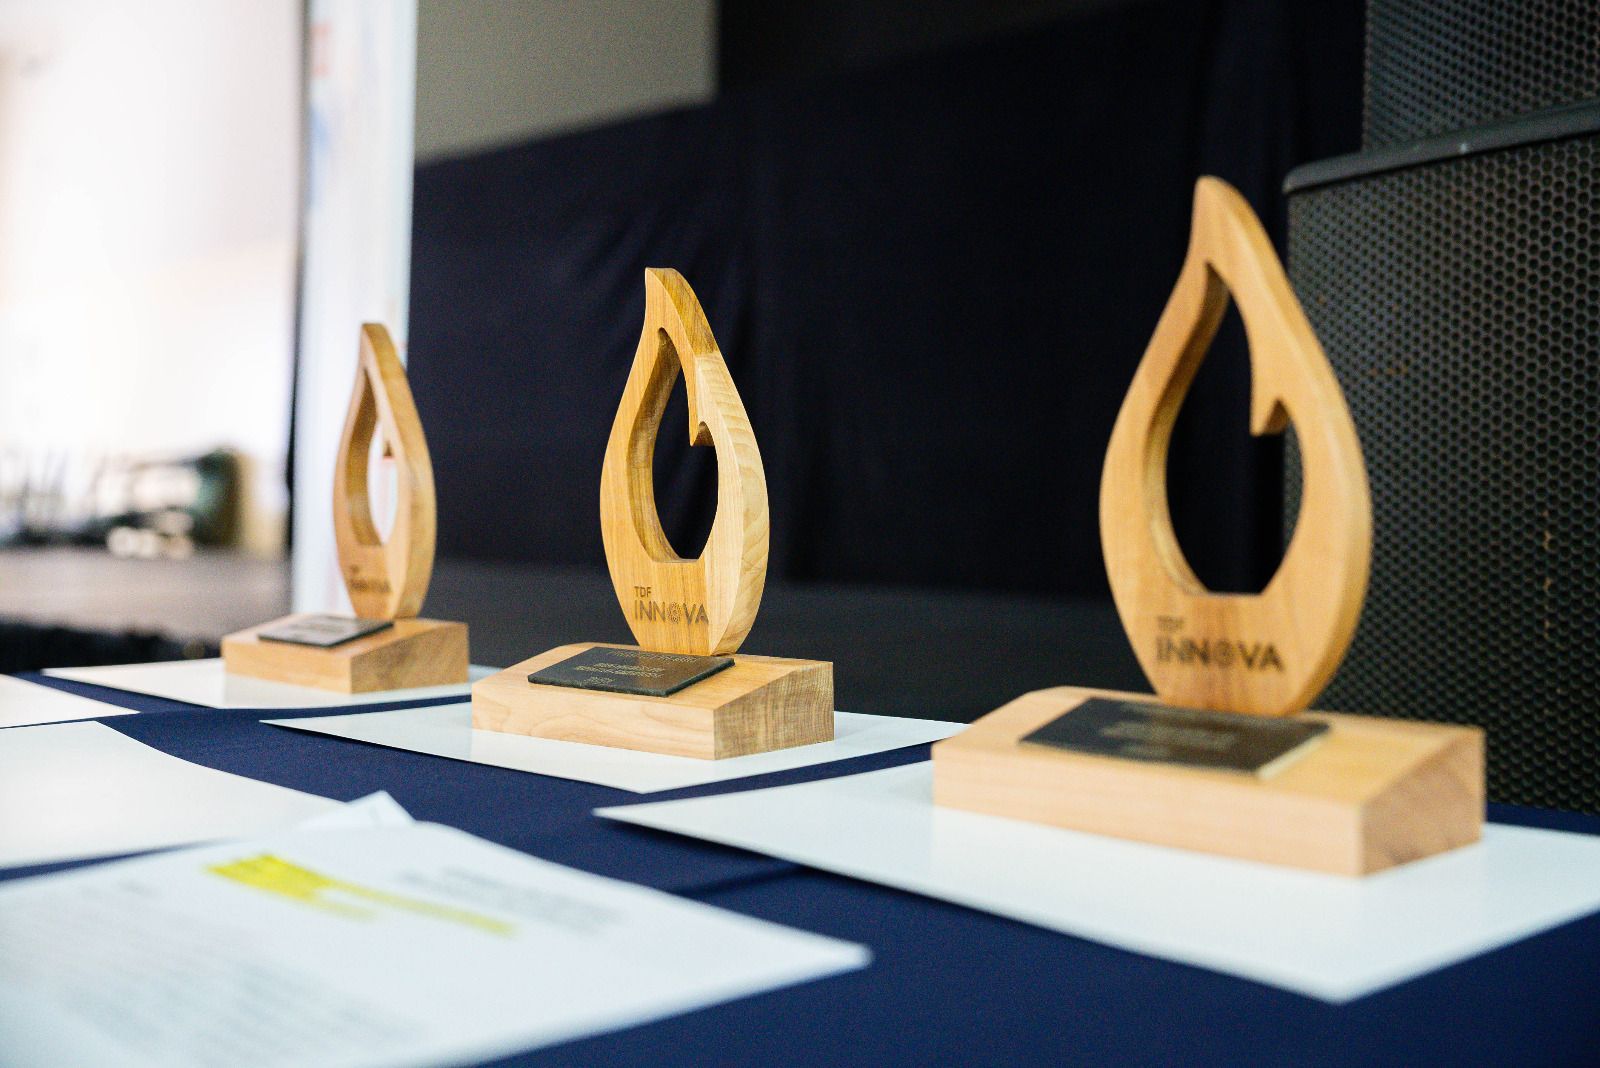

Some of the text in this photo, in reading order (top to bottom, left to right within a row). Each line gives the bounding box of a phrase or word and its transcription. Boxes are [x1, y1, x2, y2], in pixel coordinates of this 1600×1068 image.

[633, 585, 652, 598] TDF
[633, 599, 709, 625] INNOVA
[1156, 636, 1286, 672] INNOVA
